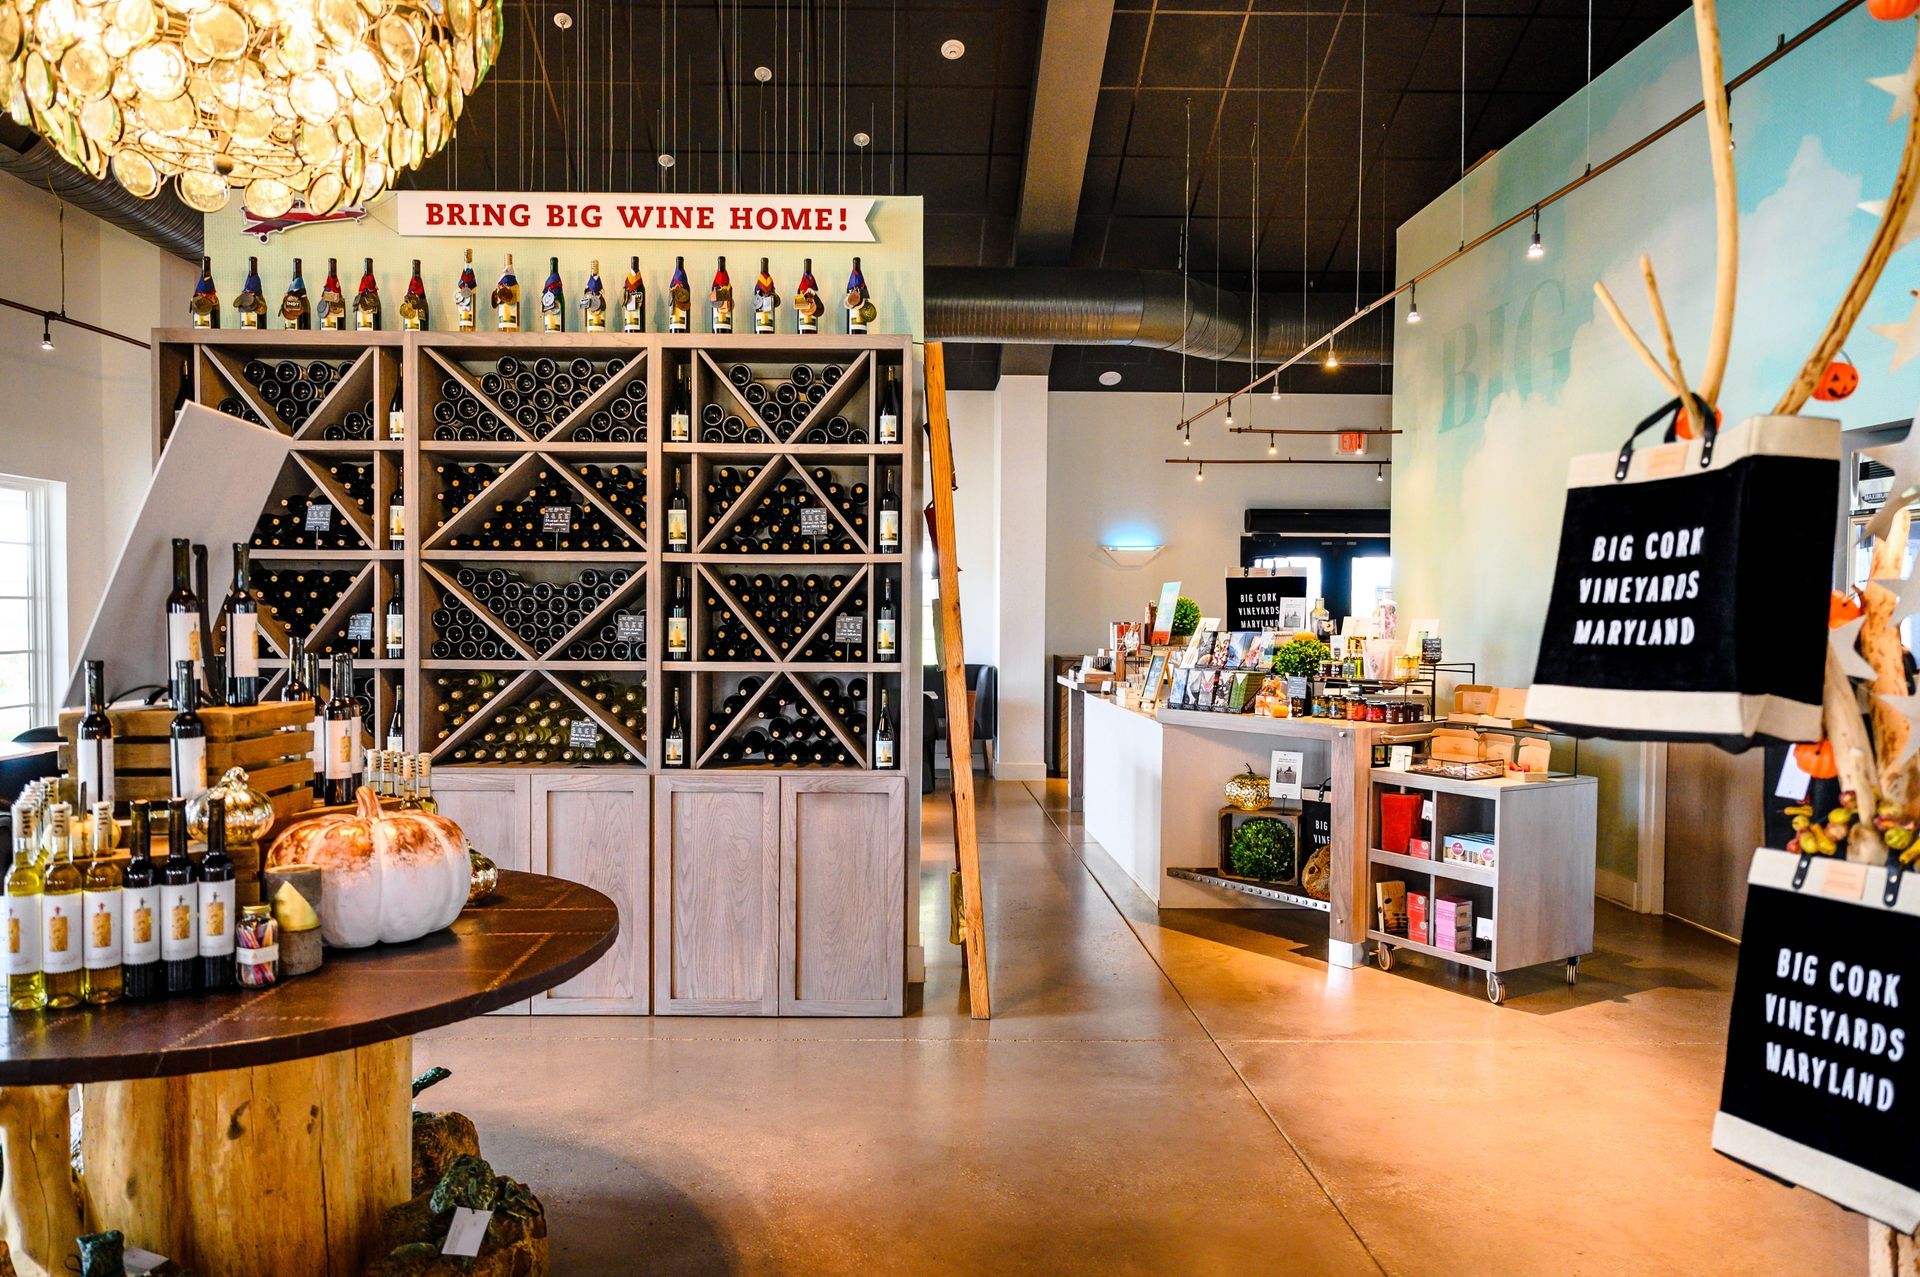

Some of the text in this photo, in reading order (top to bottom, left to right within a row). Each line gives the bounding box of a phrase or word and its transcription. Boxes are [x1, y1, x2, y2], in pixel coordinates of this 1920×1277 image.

[425, 202, 848, 232] BRING BIG WINE HOME!
[1439, 278, 1571, 434] BIG
[1591, 526, 1706, 563] BIG CORK
[1240, 593, 1277, 603] BIG CORK
[1578, 570, 1700, 604] VINEYARDS
[1238, 607, 1280, 616] VINEYARDS
[1240, 619, 1280, 629] MARYLAND
[1572, 616, 1696, 646] MARYLAND
[1315, 820, 1328, 831] BIG
[1776, 947, 1902, 1008] BIG CORK
[1765, 992, 1906, 1063] VINEYARDS
[1766, 1041, 1896, 1112] MARYLAND
